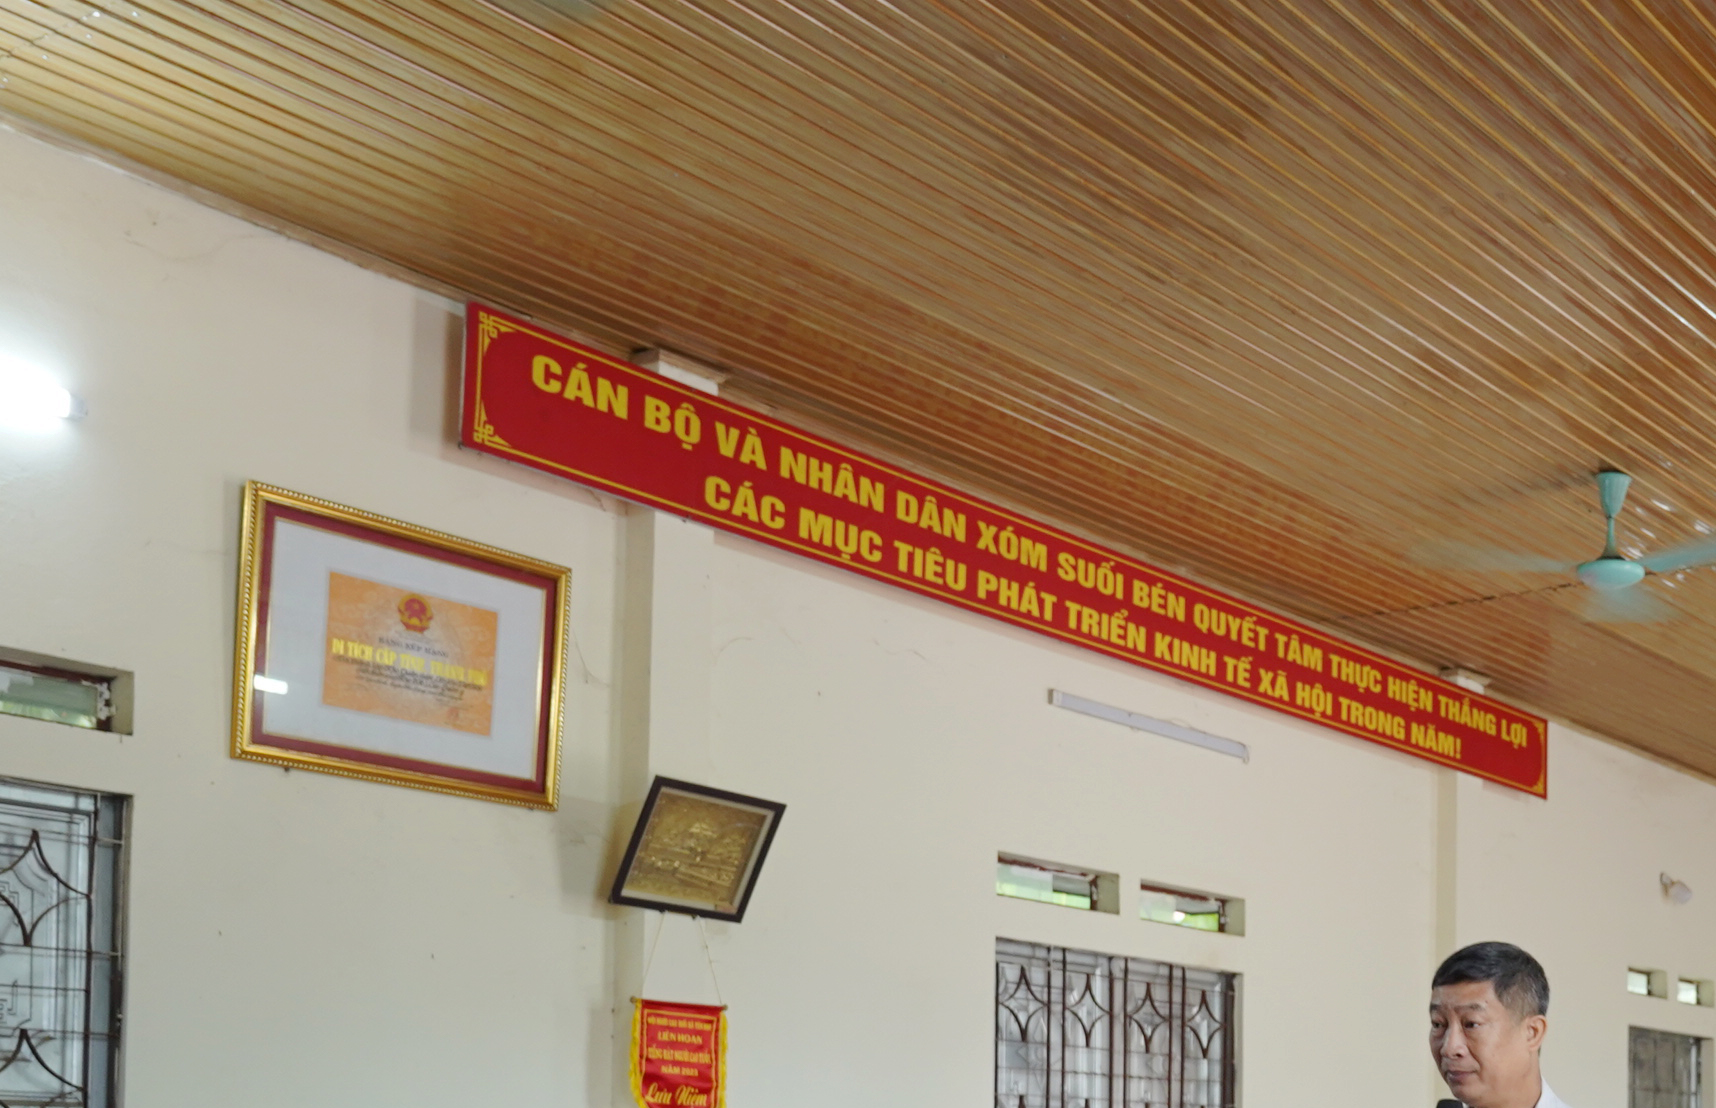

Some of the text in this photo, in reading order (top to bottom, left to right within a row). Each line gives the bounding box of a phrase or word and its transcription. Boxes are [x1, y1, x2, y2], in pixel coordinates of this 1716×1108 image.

[531, 354, 1528, 750] CÁN BỘ VÀ NHÂN DÂN XÓM SUỐI BÉN QUYẾT TÂM THỰC HIỆN THẮNG LỢI
[704, 475, 1463, 760] CÁC MỤC TIÊU PHÁT TRIỂN KINH TẾ XÃ HỘI TRONG NĂM!
[657, 1029, 703, 1045] LIÊN HOAN
[661, 1064, 681, 1074] NĂM
[645, 1082, 672, 1105] Lưu
